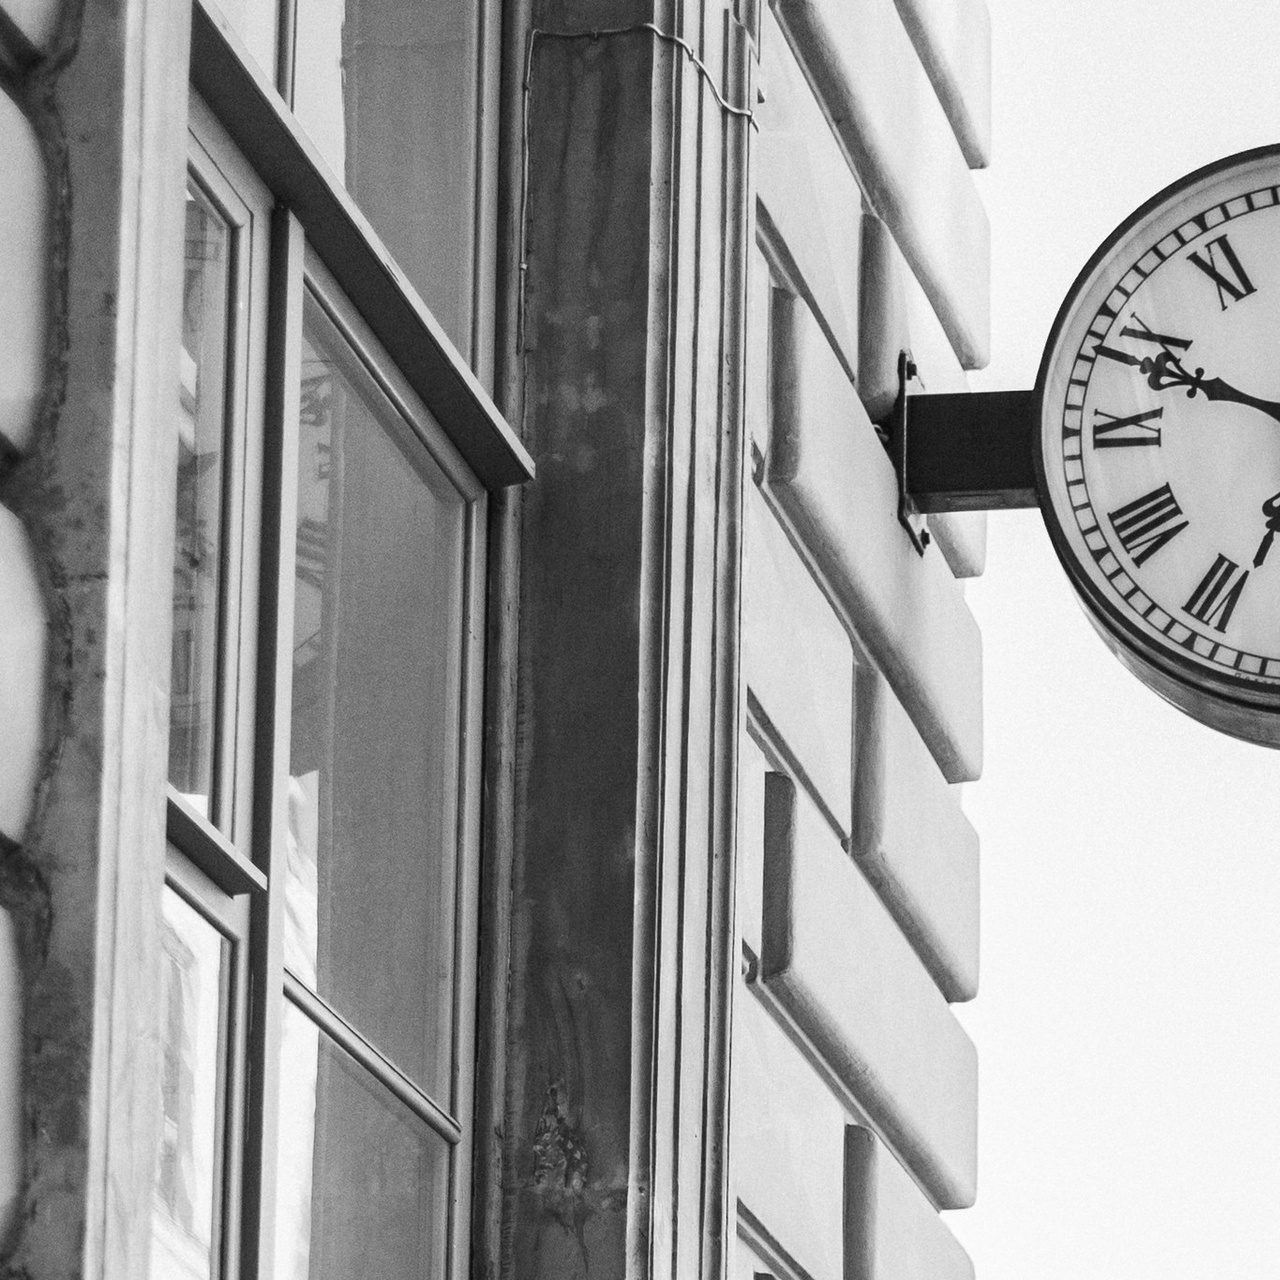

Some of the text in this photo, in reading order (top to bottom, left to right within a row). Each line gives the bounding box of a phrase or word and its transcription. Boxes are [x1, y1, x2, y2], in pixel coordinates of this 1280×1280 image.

[1186, 234, 1257, 311] XI
[1119, 311, 1193, 361] X
[1093, 407, 1164, 449] IX
[1107, 482, 1190, 568] VIII
[1181, 553, 1250, 634] VII
